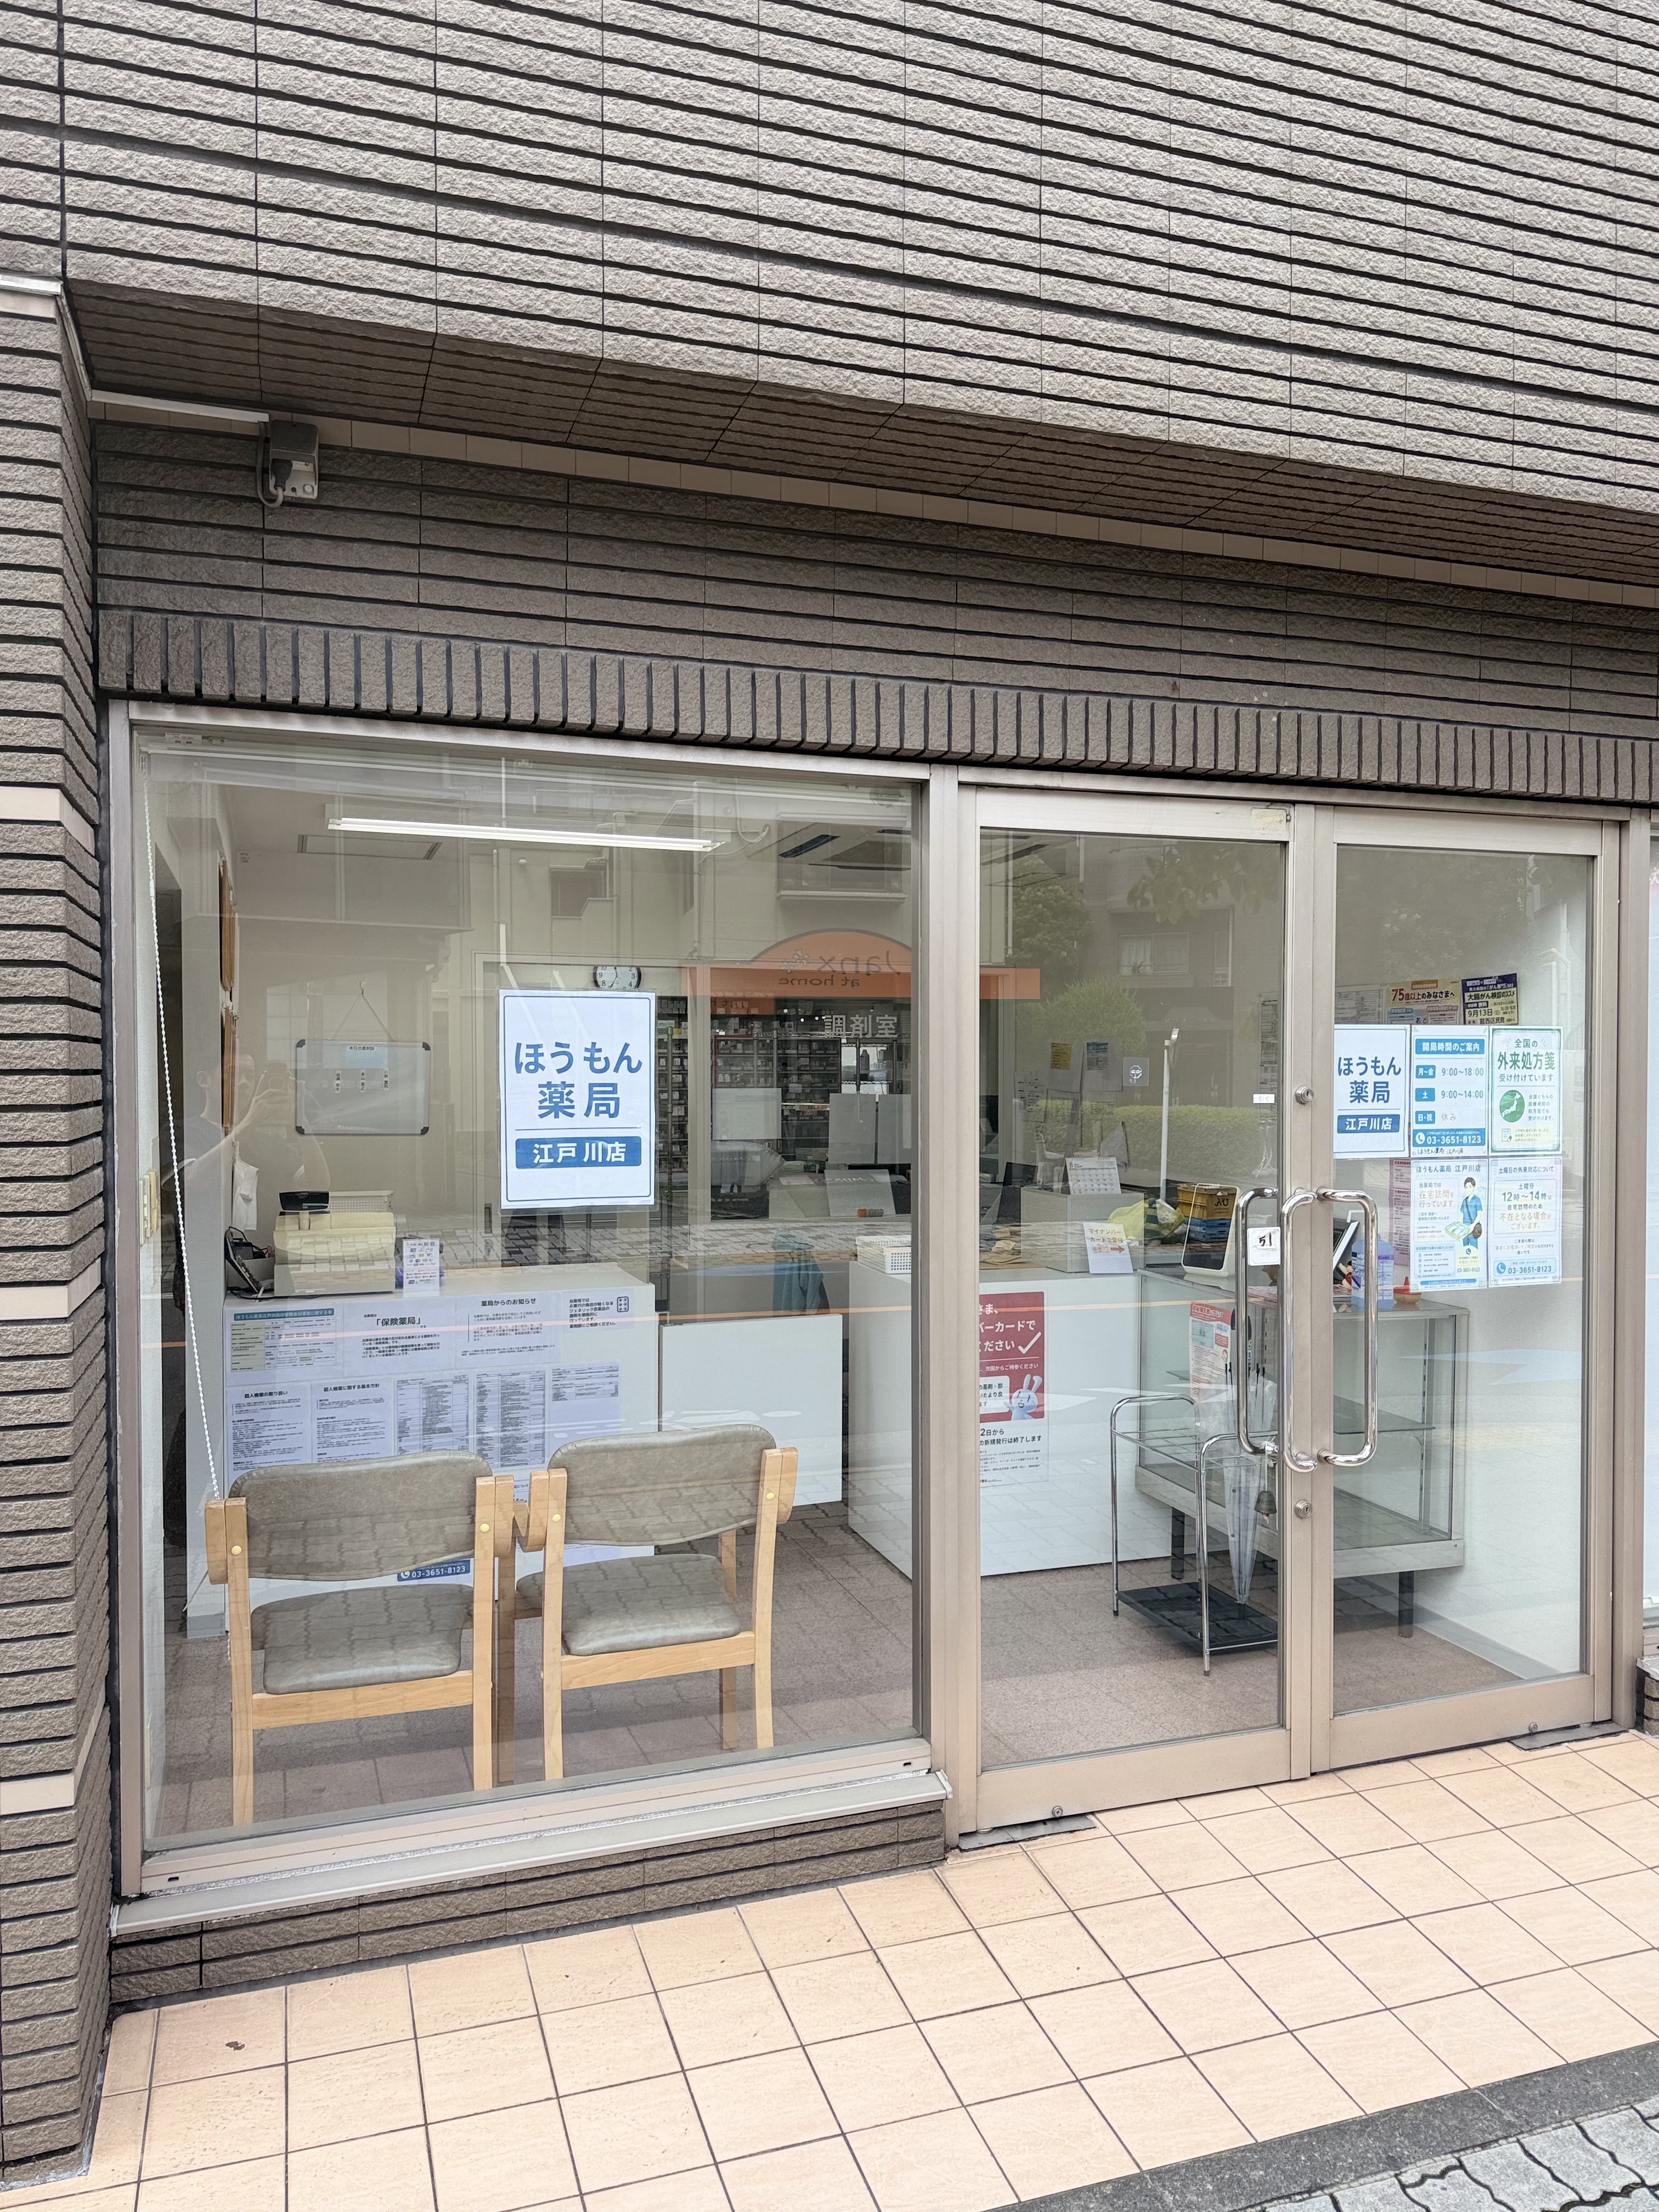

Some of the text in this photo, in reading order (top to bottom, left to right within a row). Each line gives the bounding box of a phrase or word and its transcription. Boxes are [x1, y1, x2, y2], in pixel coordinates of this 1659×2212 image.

[1392, 988, 1455, 1002] 75歳以上のみなさまへ
[1468, 990, 1515, 1001] 大腸がん検診のススメ
[823, 1014, 899, 1039] 調剤室
[1422, 1042, 1480, 1052] 開局時間のご案内
[1514, 1038, 1538, 1048] 全国の
[515, 1042, 642, 1074] ほうもん
[1497, 1051, 1555, 1070] 外来処方箋
[1338, 1057, 1401, 1076] ほうもん
[1499, 1073, 1554, 1082] 受け付けています
[1350, 1080, 1390, 1103] 薬局
[1422, 1091, 1428, 1099] 土
[538, 1081, 620, 1119] 薬局
[1441, 1113, 1456, 1121] 休み
[1345, 1117, 1392, 1130] 江戸川店
[1427, 1135, 1481, 1144] 03-3651-8123
[533, 1142, 626, 1164] 江戸川店
[1455, 1164, 1481, 1172] 江戸川店
[1419, 1190, 1454, 1199] 在宅訪問を
[1419, 1200, 1453, 1208] 行っています
[1500, 1211, 1551, 1221] 不在となる場合が
[1508, 1266, 1551, 1274] 03-3651-8123
[481, 1298, 536, 1307] 薬局からのお知らせ
[376, 1317, 420, 1327] 「保険薬局」
[979, 1340, 1015, 1352] ださい
[324, 1383, 380, 1392] 個人情報に関する基本方針
[980, 1428, 1005, 1436] 2日から
[411, 1565, 466, 1578] 03-3651-8123
